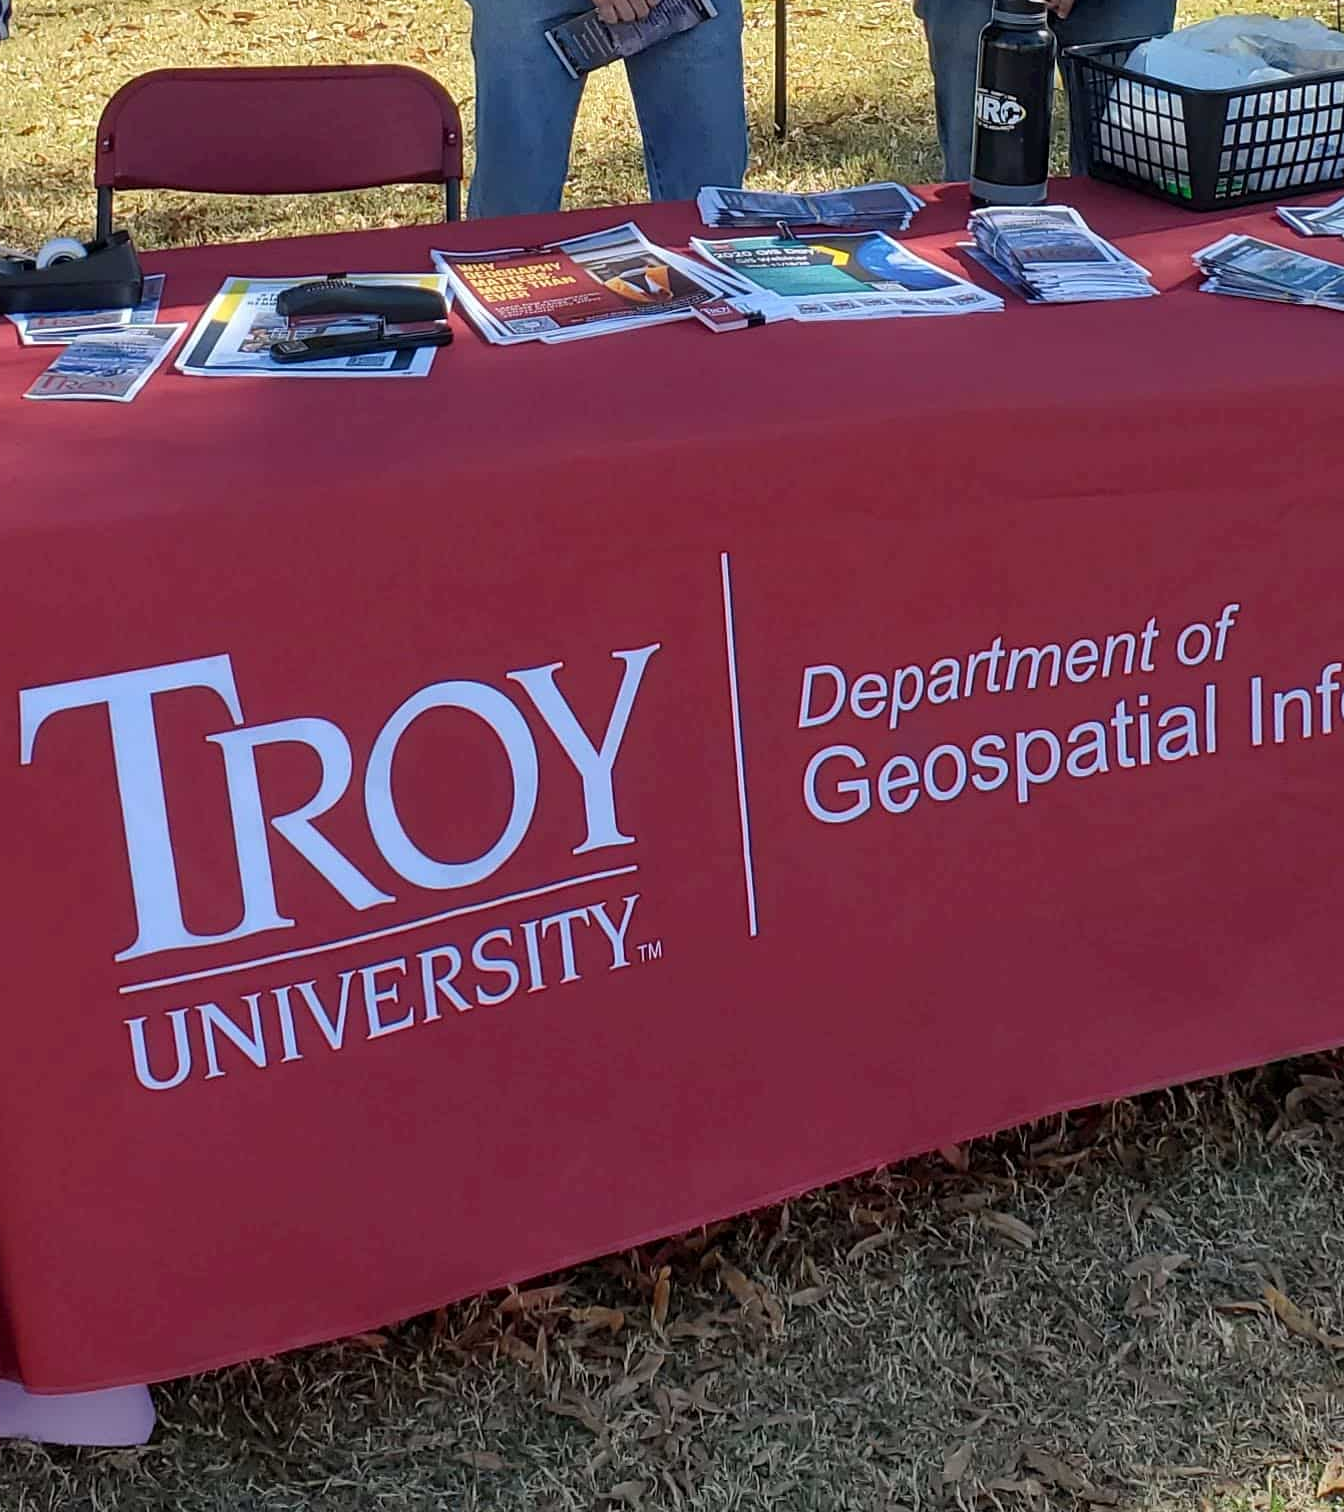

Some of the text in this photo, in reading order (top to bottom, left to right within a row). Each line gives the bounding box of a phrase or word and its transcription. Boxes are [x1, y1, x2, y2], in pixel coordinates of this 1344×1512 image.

[456, 262, 496, 272] WHY
[463, 262, 561, 280] GEOGRAPHY
[476, 276, 577, 295] MORE THAN
[483, 290, 531, 303] EVER
[796, 602, 1241, 729] Department of
[801, 682, 1217, 825] Geospatial
[19, 642, 661, 963] TROY
[123, 893, 641, 1091] UNIVERSITY
